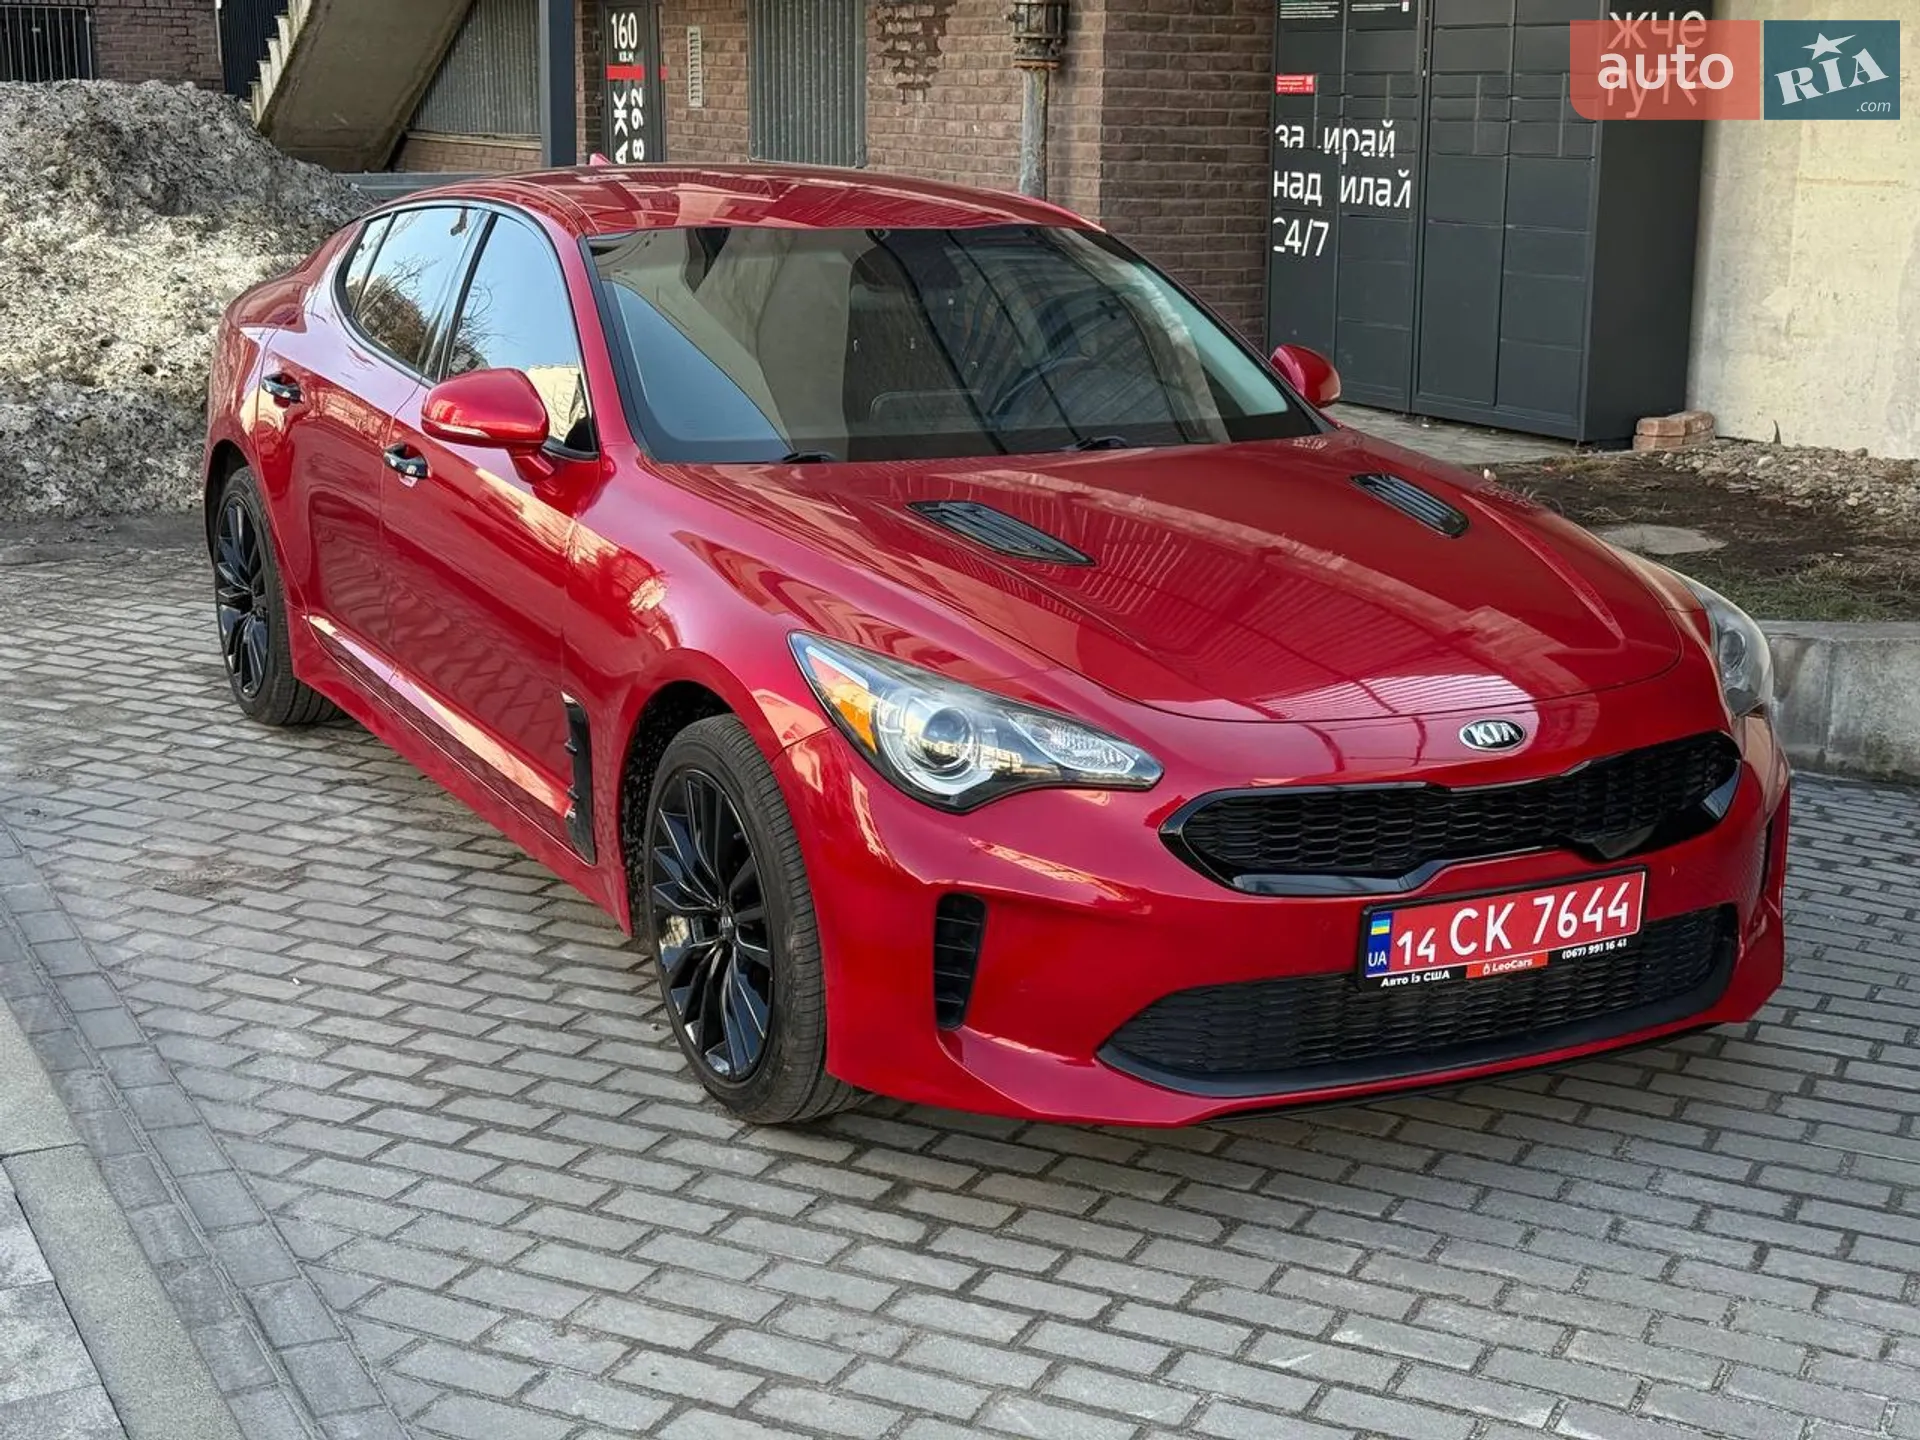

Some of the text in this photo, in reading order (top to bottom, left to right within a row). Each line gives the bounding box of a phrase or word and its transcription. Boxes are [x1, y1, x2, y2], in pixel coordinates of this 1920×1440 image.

[611, 12, 638, 50] 160
[1274, 119, 1396, 165] заирай
[1467, 721, 1521, 746] KIA
[1396, 882, 1630, 966] 14 CK 7644
[1367, 950, 1388, 967] UA
[1561, 947, 1587, 960] (067)
[1605, 940, 1615, 951] 16
[1492, 958, 1533, 972] LeoCars
[1380, 976, 1409, 988] Авто
[1423, 969, 1451, 982] США
